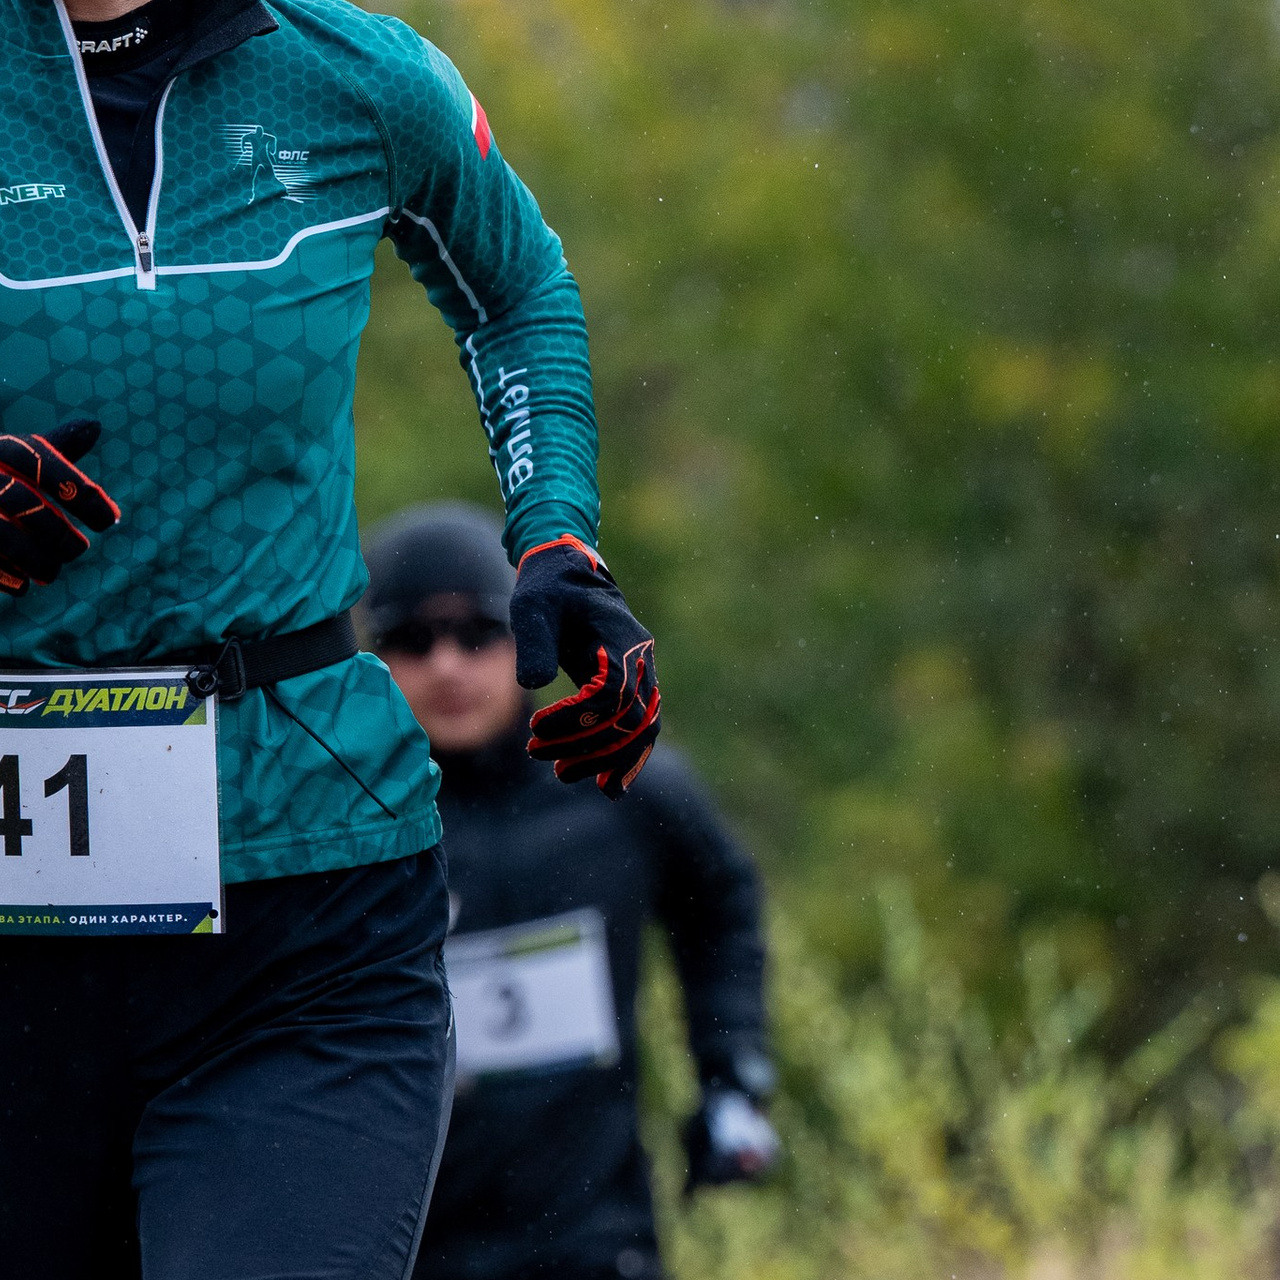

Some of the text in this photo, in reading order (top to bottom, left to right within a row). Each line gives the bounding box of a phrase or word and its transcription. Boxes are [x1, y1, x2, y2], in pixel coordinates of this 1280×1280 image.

[41, 686, 189, 717] ДУАТЛОН
[18, 915, 66, 924] ЭТАПА.
[69, 914, 107, 925] ОДИН
[111, 913, 188, 924] ХАРАКТЕР.
